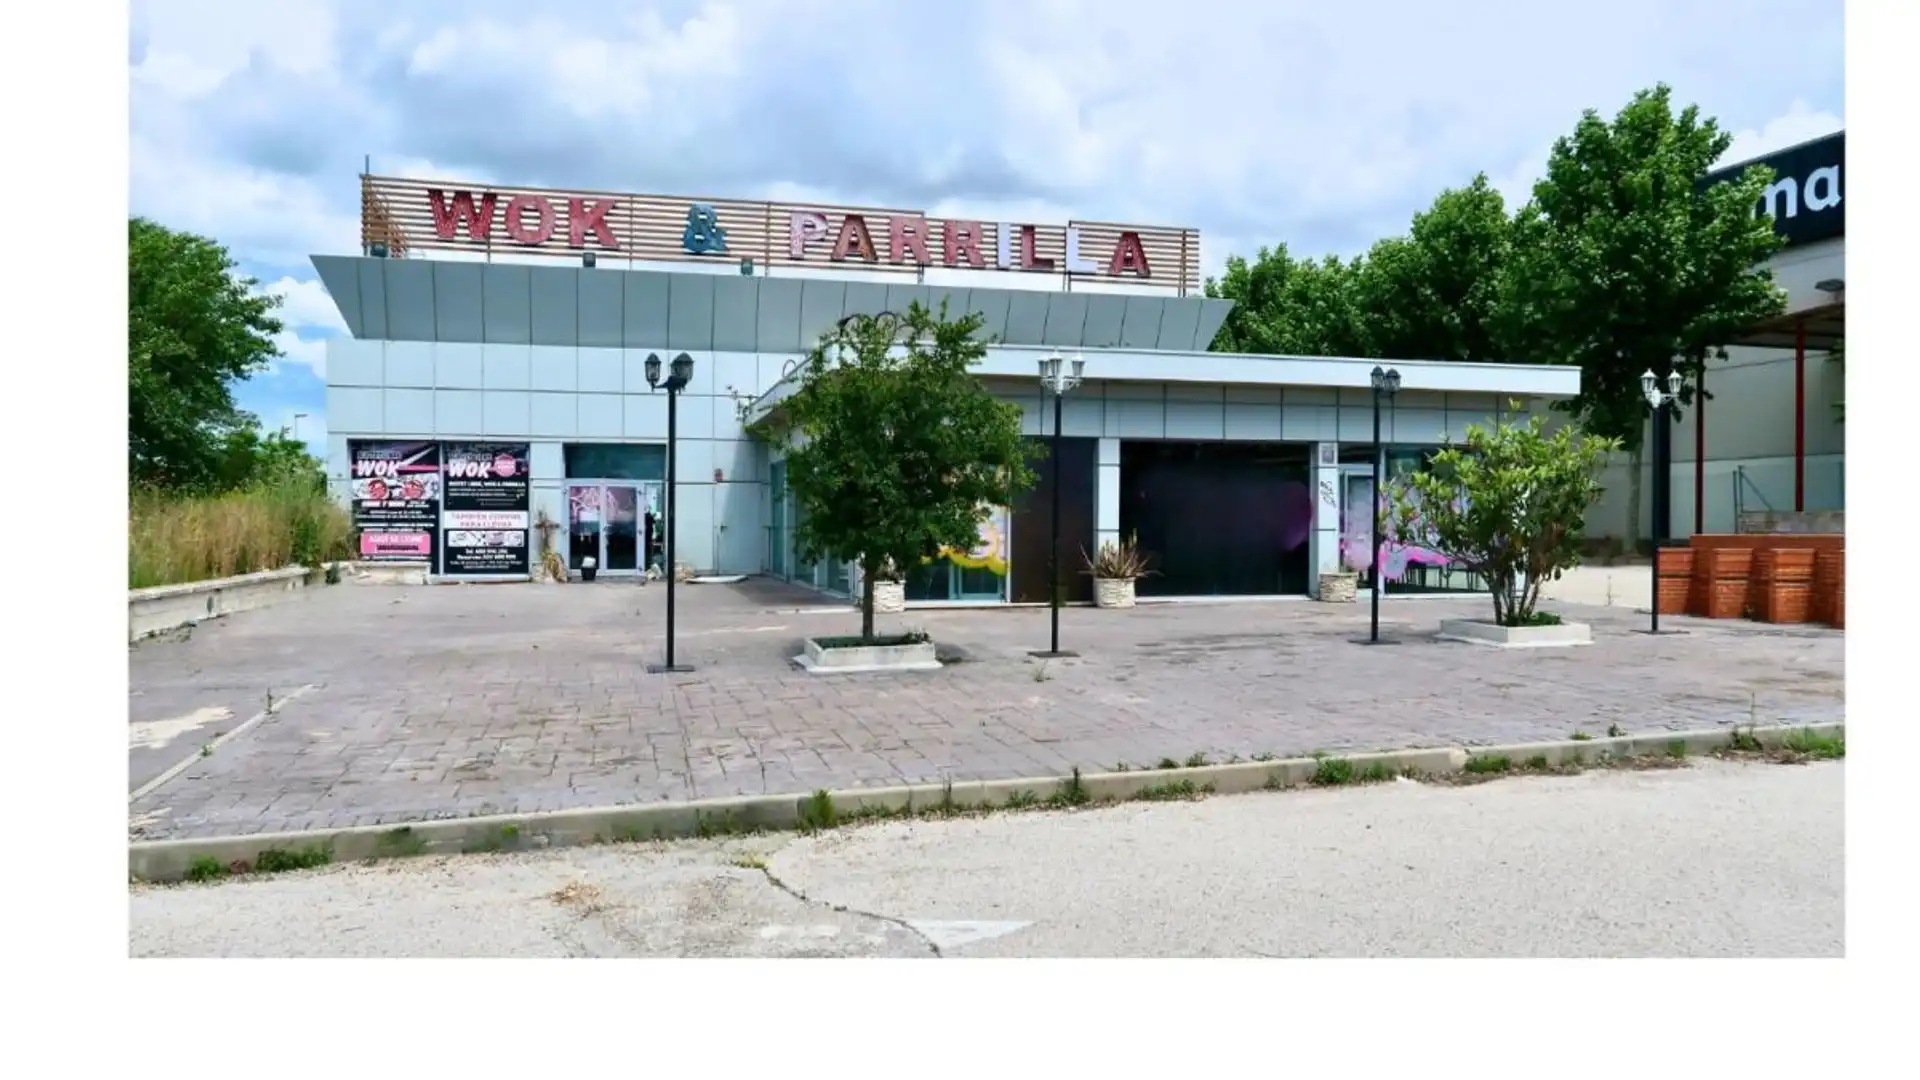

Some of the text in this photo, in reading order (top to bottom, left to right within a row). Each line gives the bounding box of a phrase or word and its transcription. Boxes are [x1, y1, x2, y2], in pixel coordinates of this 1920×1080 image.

[427, 187, 1152, 278] WOK & PARRILLA
[356, 459, 400, 477] WOK
[448, 459, 492, 479] WOK
